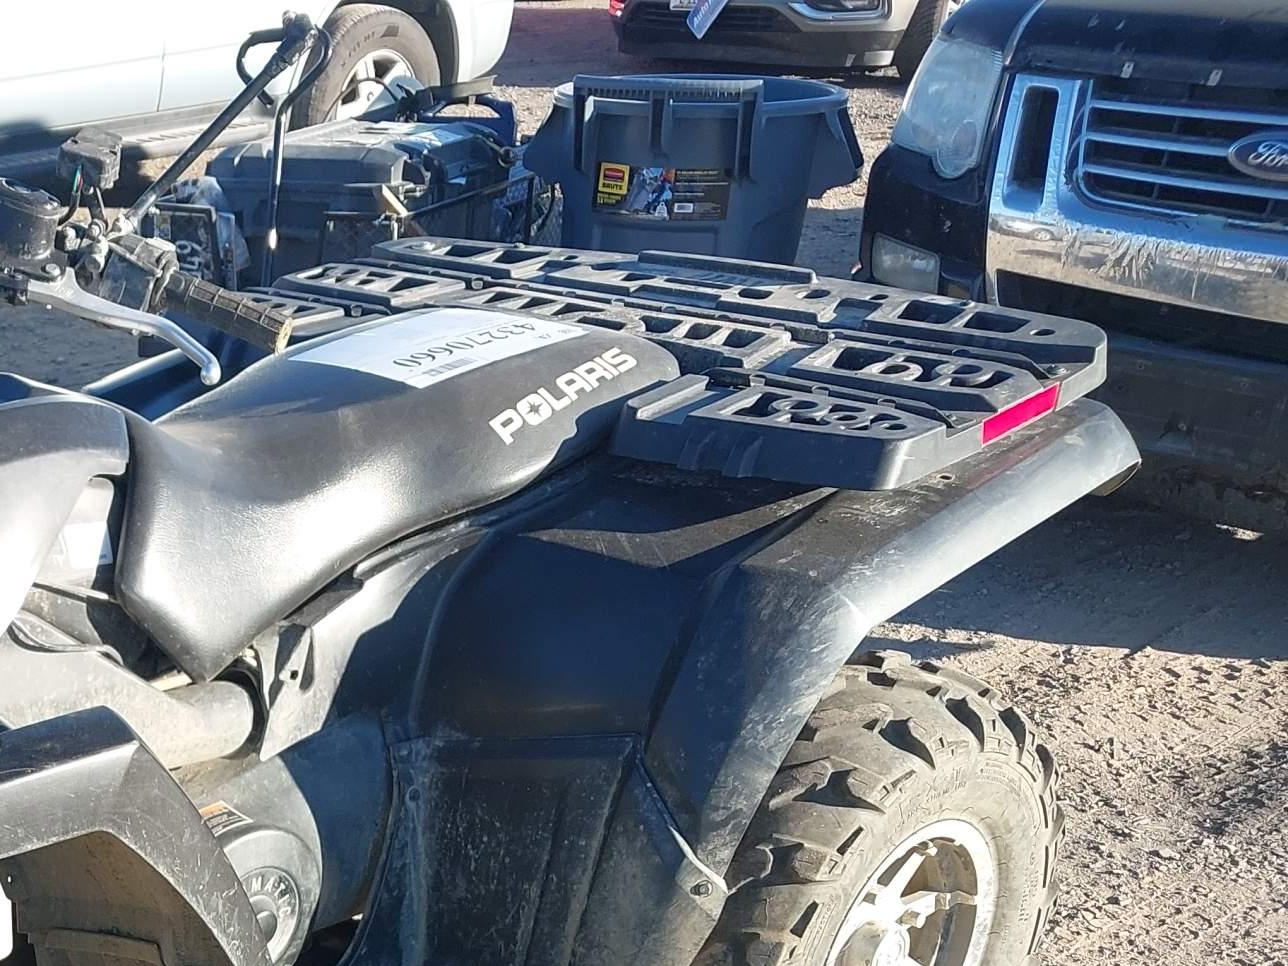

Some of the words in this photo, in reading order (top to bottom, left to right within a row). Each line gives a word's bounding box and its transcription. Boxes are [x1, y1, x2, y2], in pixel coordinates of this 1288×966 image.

[1248, 141, 1288, 168] For
[393, 322, 537, 369] 43270660
[488, 347, 638, 446] POLARIS
[250, 875, 291, 917] MATIC
